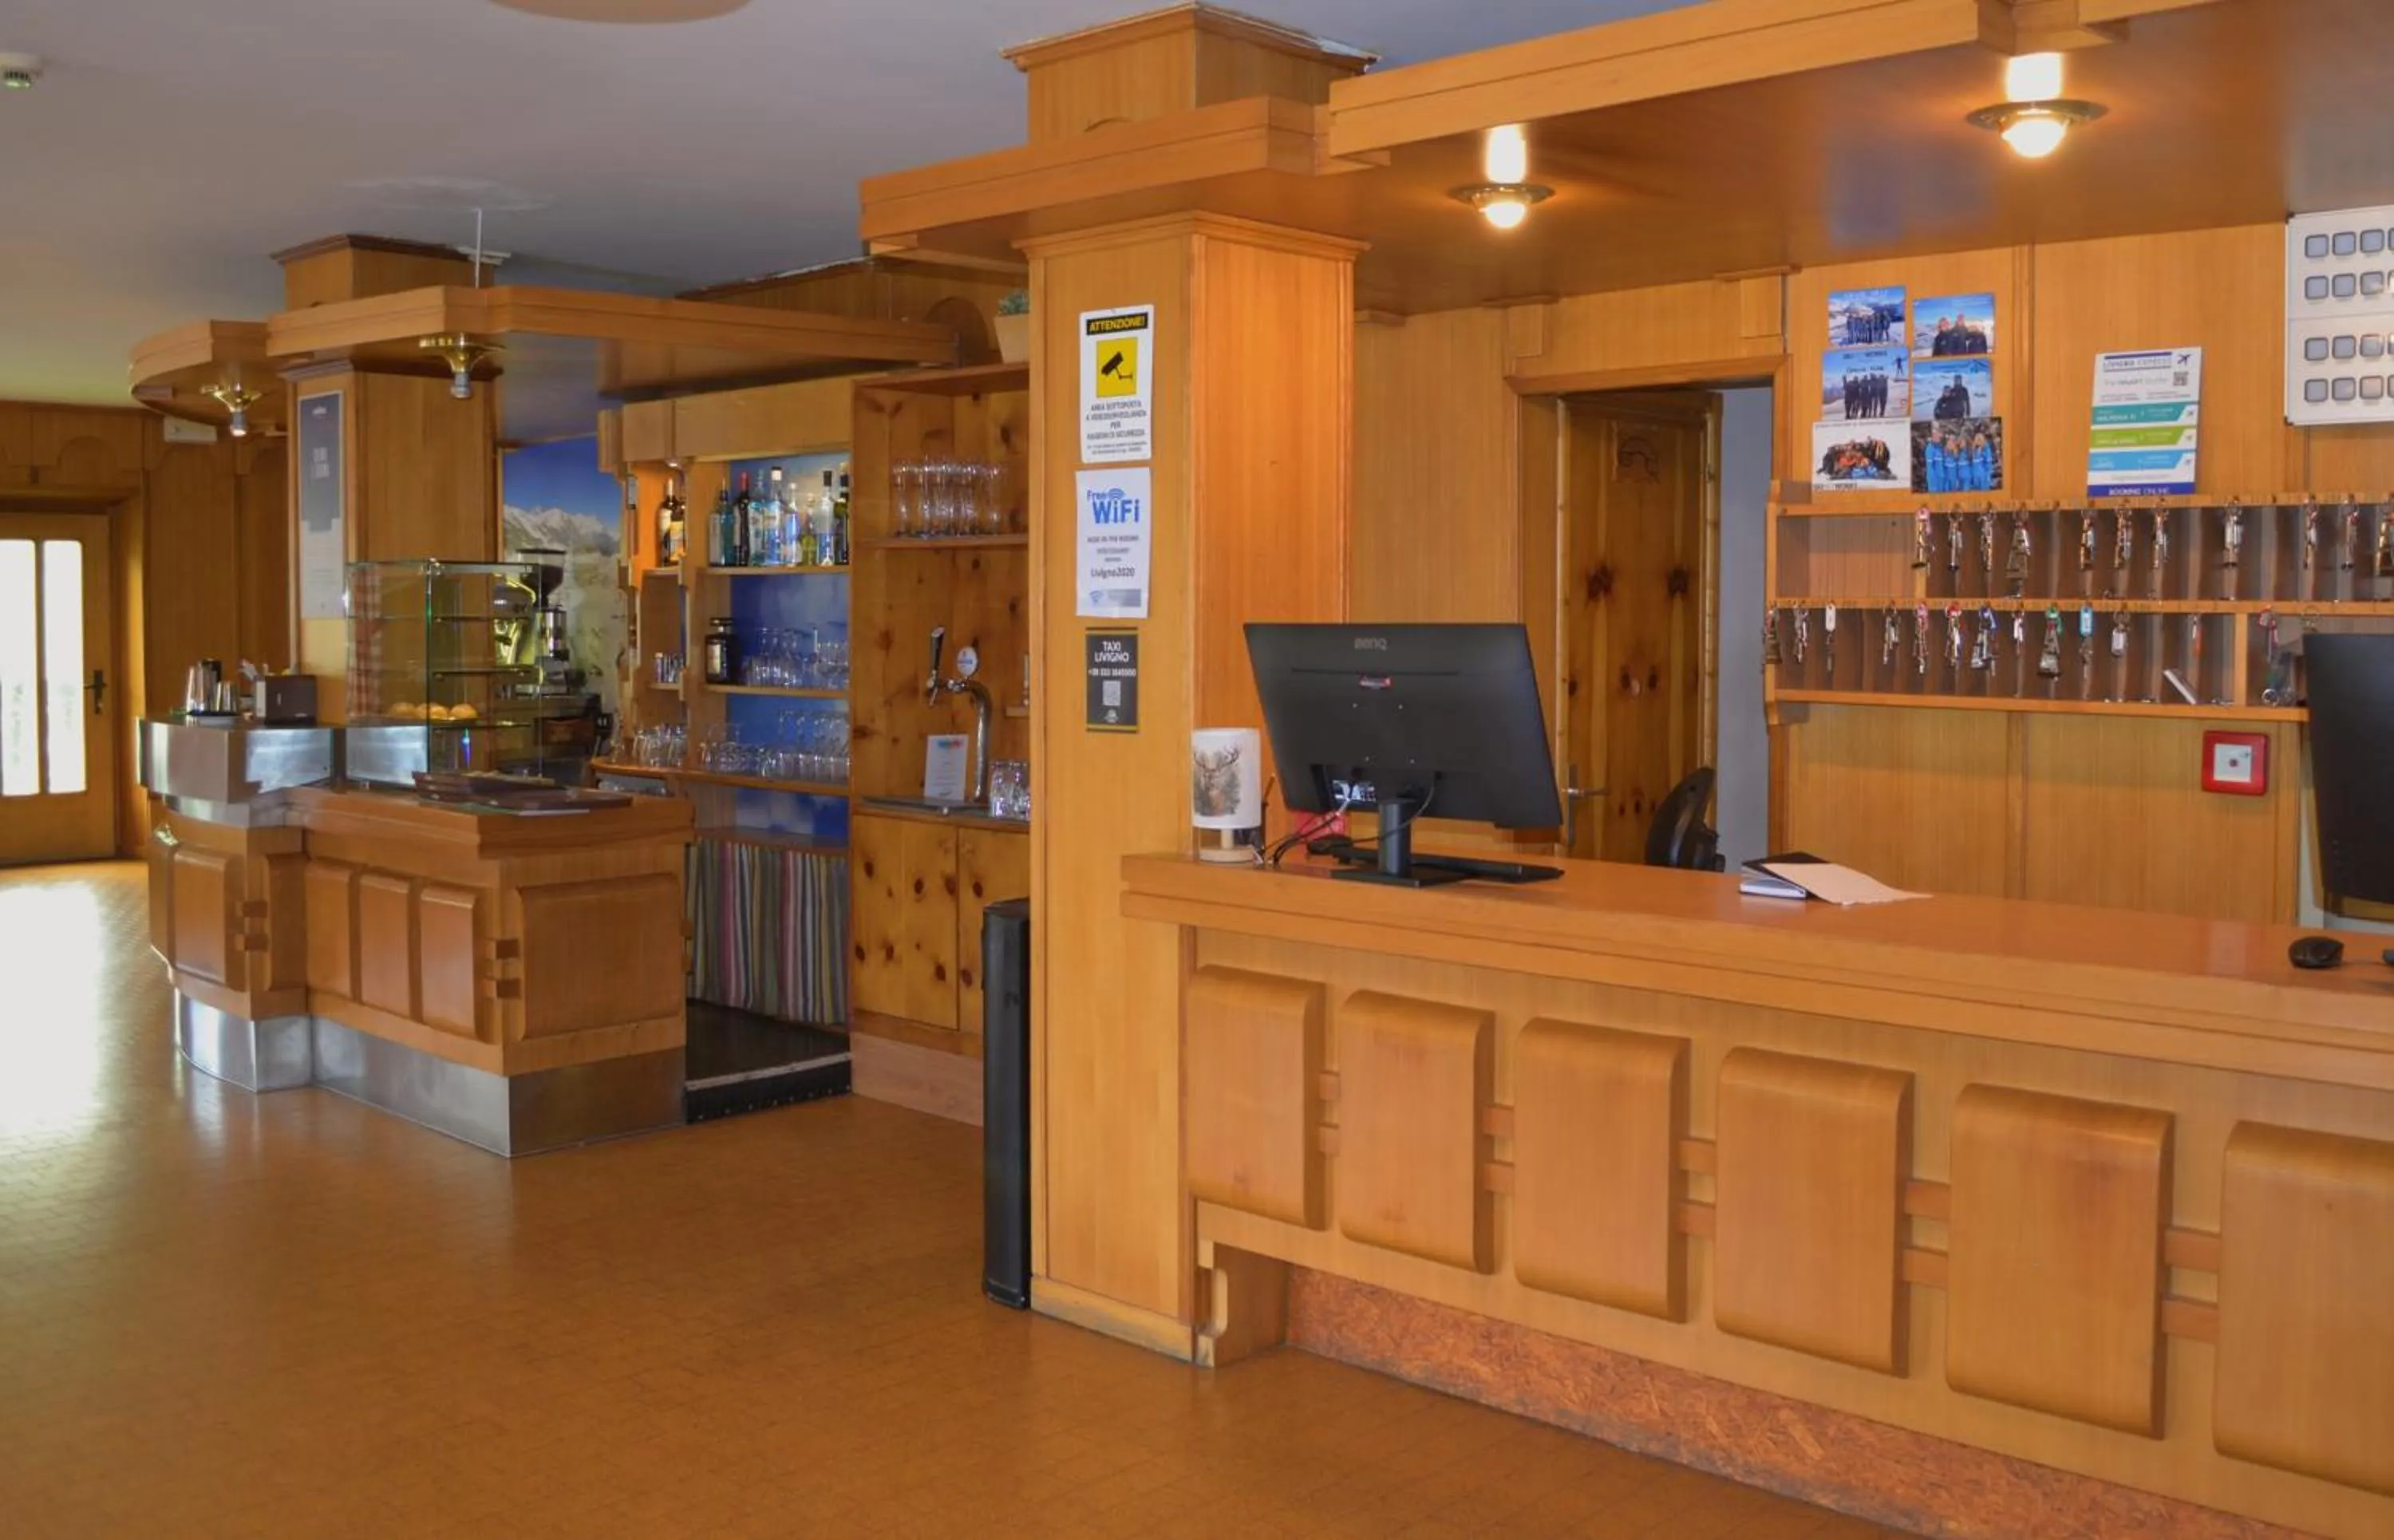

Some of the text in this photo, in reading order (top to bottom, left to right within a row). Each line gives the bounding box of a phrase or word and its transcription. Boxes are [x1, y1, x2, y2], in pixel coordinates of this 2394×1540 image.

[1089, 315, 1144, 332] ATTENZIONE!
[1086, 489, 1108, 501] Free
[1092, 498, 1140, 524] WiFi
[1103, 641, 1121, 652] TAXI
[1094, 652, 1129, 662] LIVIGNO
